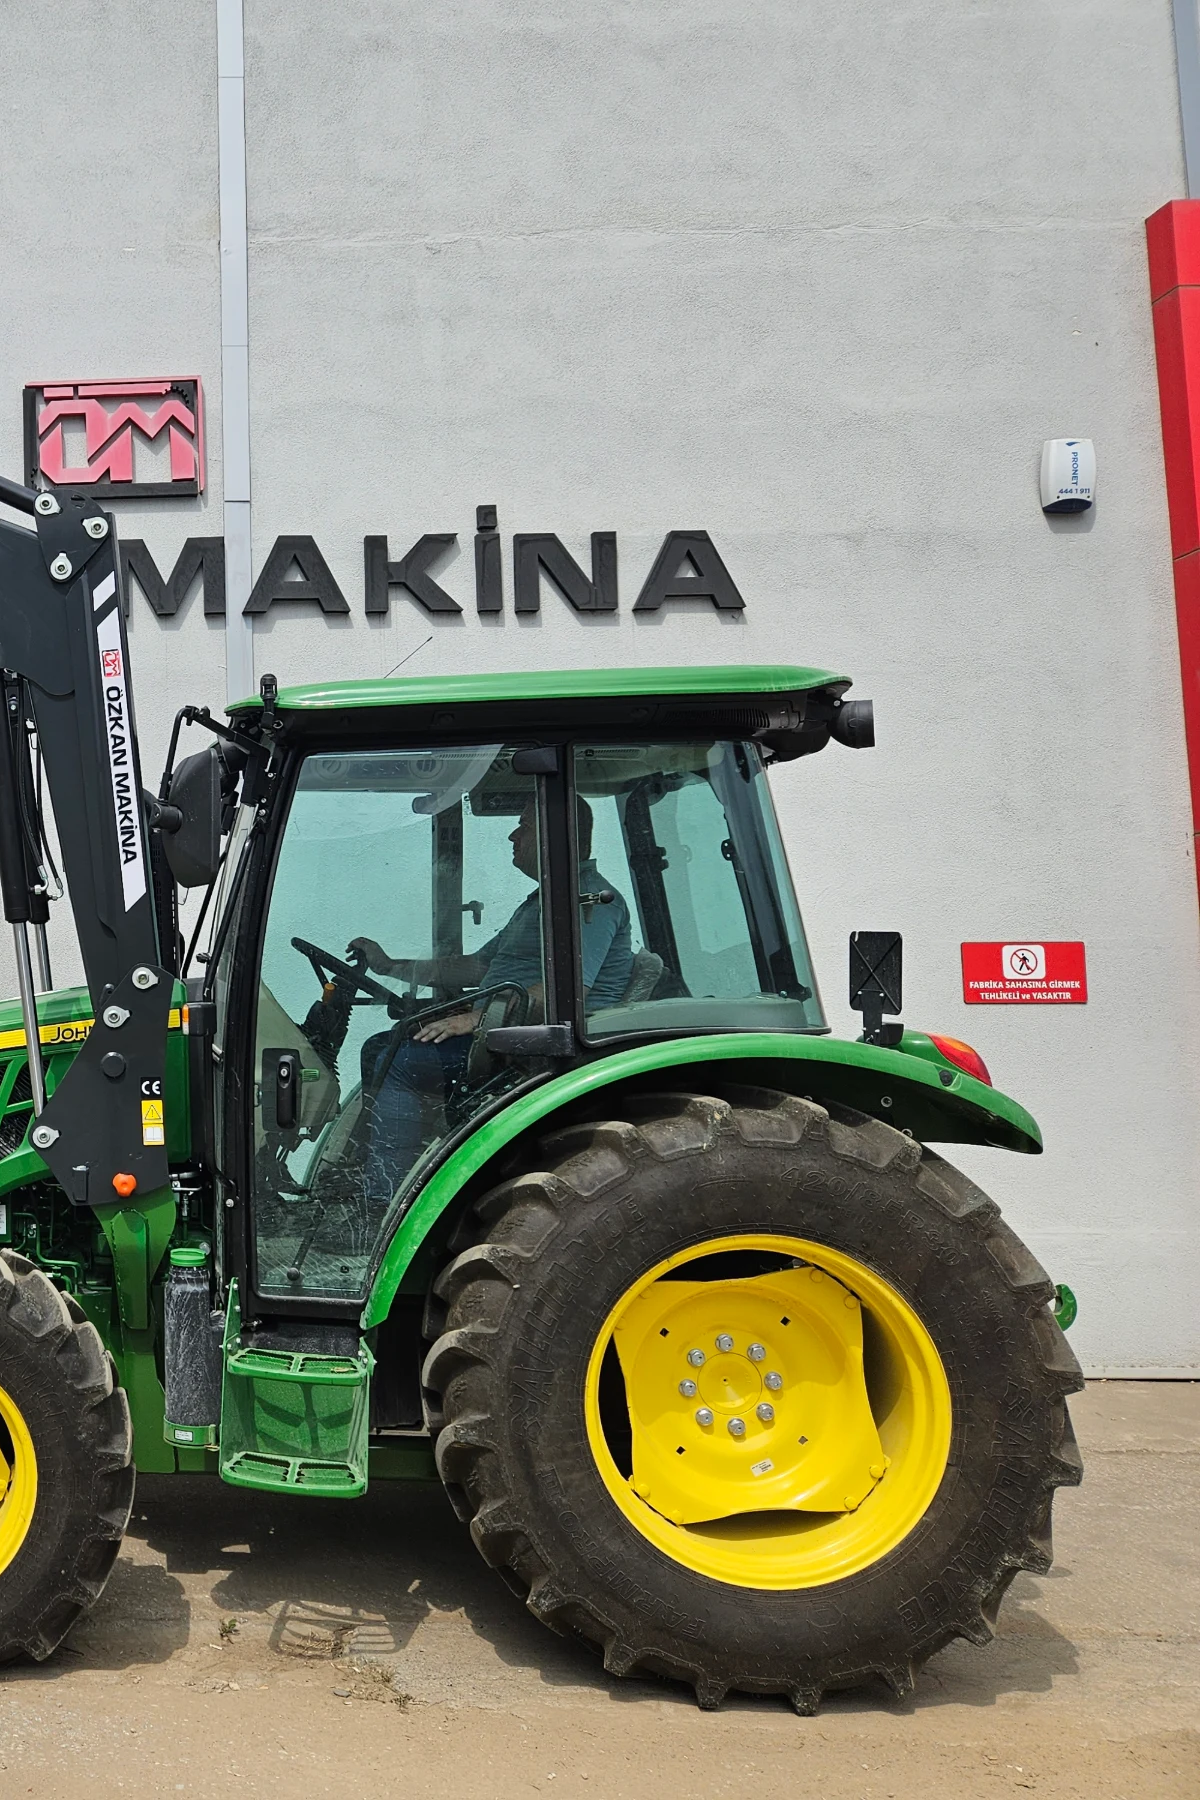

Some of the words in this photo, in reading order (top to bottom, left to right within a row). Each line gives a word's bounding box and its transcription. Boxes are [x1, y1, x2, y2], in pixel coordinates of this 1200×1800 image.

[1071, 452, 1079, 486] PRONET
[119, 504, 747, 617] MAKİNA
[106, 686, 128, 767] ÖZKAN
[114, 772, 138, 865] MAKİNA
[969, 980, 1004, 989] FABRİKA
[1005, 981, 1047, 989] SAHASINA
[1049, 979, 1080, 989] GİRMEK
[980, 990, 1020, 1000] TEHLİKELİ
[1032, 992, 1071, 1000] YASAKTIR
[141, 1080, 161, 1095] CE
[511, 1192, 647, 1405] ALLIANCE
[896, 1419, 1034, 1636] ALLIANCE
[557, 1510, 707, 1639] FARMPRO
